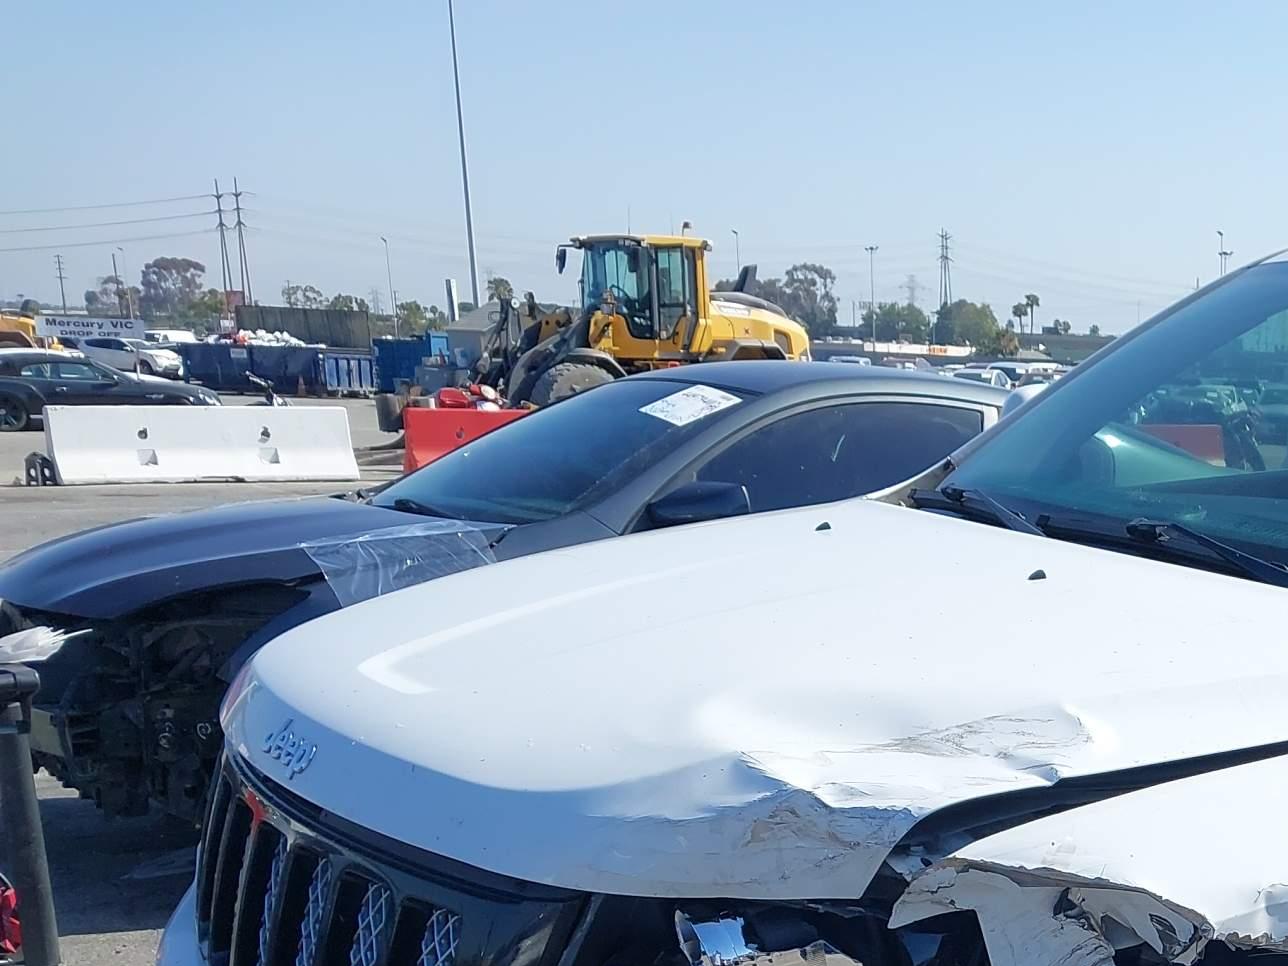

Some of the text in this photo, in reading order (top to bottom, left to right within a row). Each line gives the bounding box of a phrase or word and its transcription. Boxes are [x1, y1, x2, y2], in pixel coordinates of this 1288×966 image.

[45, 317, 134, 330] Mercury VIC
[60, 329, 93, 337] DROP
